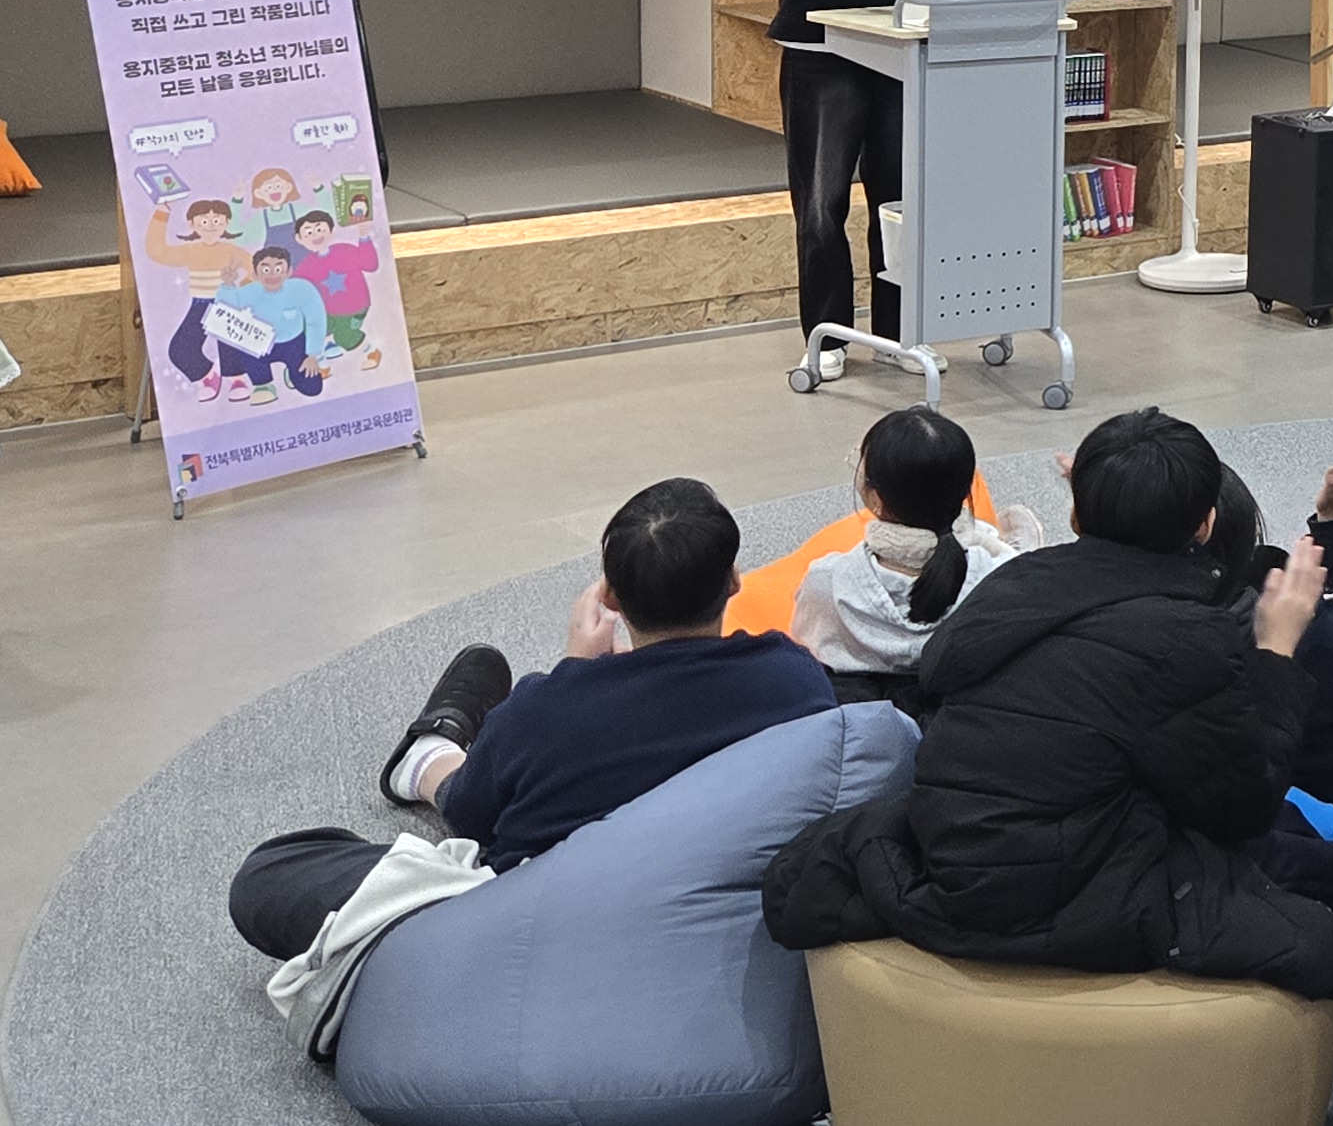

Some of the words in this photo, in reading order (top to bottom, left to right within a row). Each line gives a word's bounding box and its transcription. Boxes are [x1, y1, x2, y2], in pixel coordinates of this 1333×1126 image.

[131, 14, 167, 34] 직접
[172, 12, 208, 32] 쓰고
[212, 7, 246, 27] 그린
[250, 0, 331, 23] 작품입니다
[123, 53, 211, 79] 용지중학교
[215, 47, 267, 69] 청소년
[270, 36, 350, 63] 작가님들의
[160, 79, 195, 99] 모든
[199, 74, 234, 94] 날을
[238, 64, 326, 90] 응원합니다.
